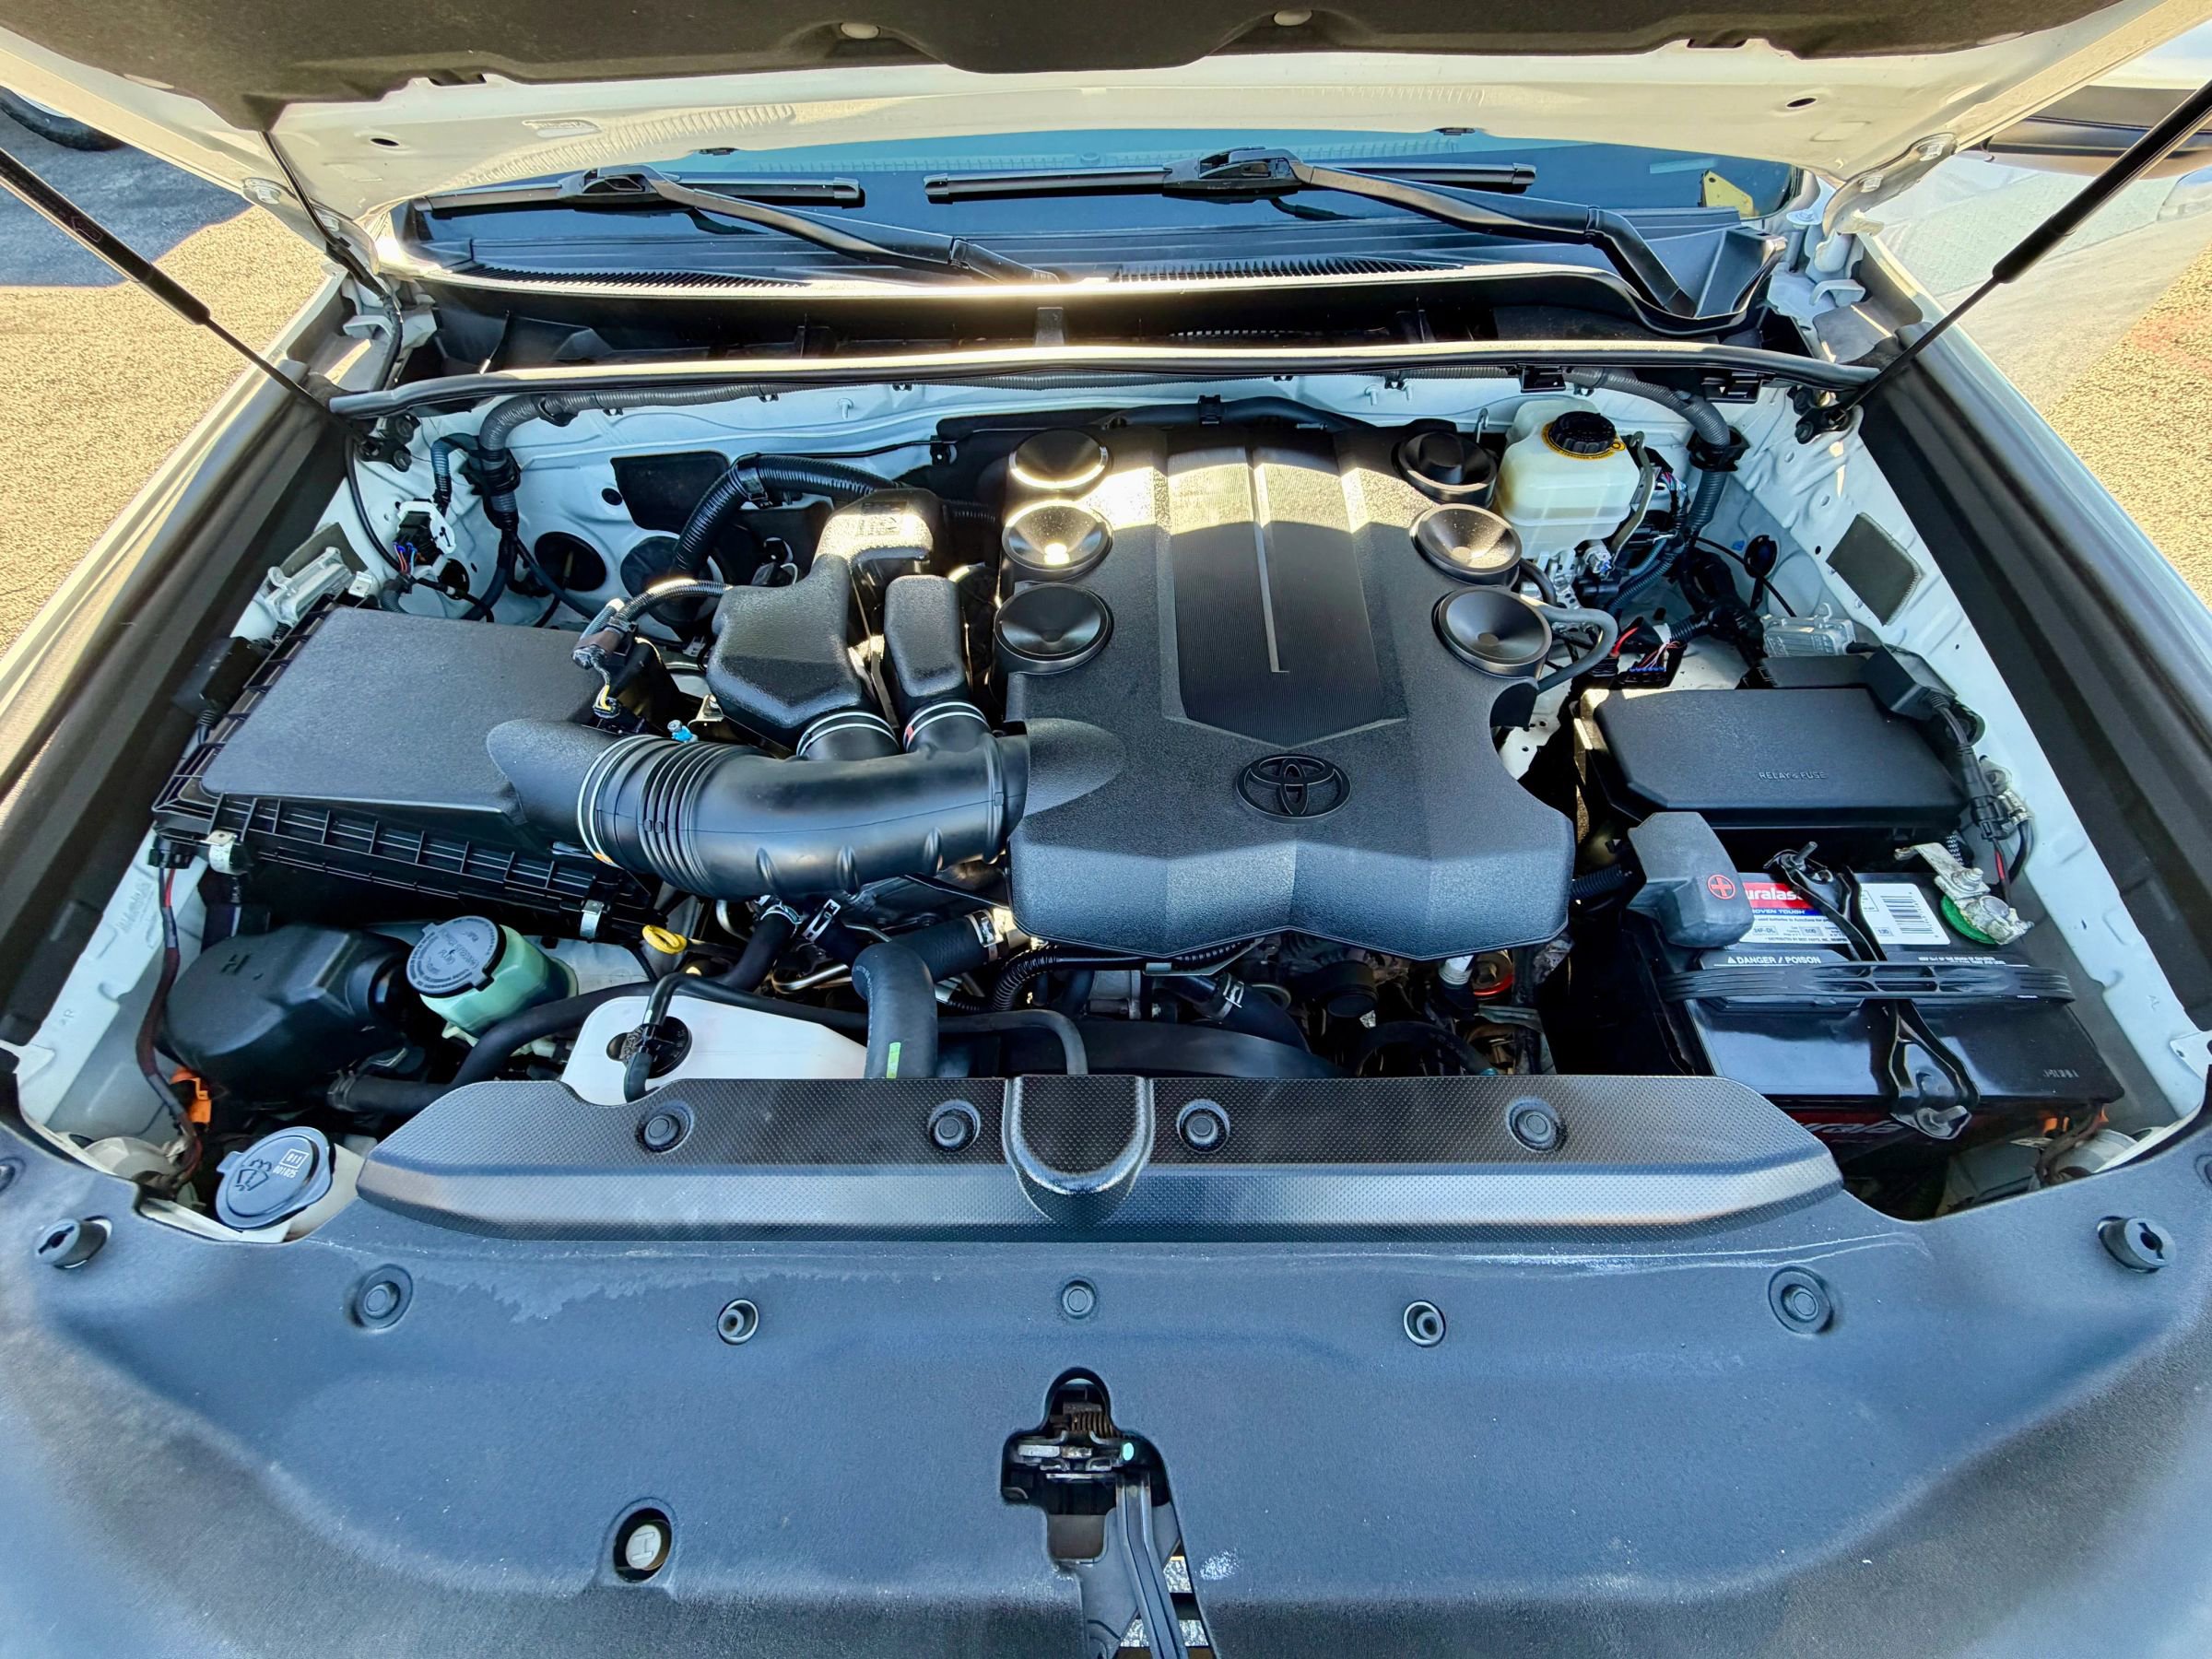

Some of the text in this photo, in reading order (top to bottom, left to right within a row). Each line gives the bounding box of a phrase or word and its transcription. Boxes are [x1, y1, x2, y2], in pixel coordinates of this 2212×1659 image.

[1800, 771, 1829, 780] FUSE
[1745, 888, 1803, 900] uralas
[1736, 956, 1777, 964] DANGER
[1785, 956, 1822, 964] POISON
